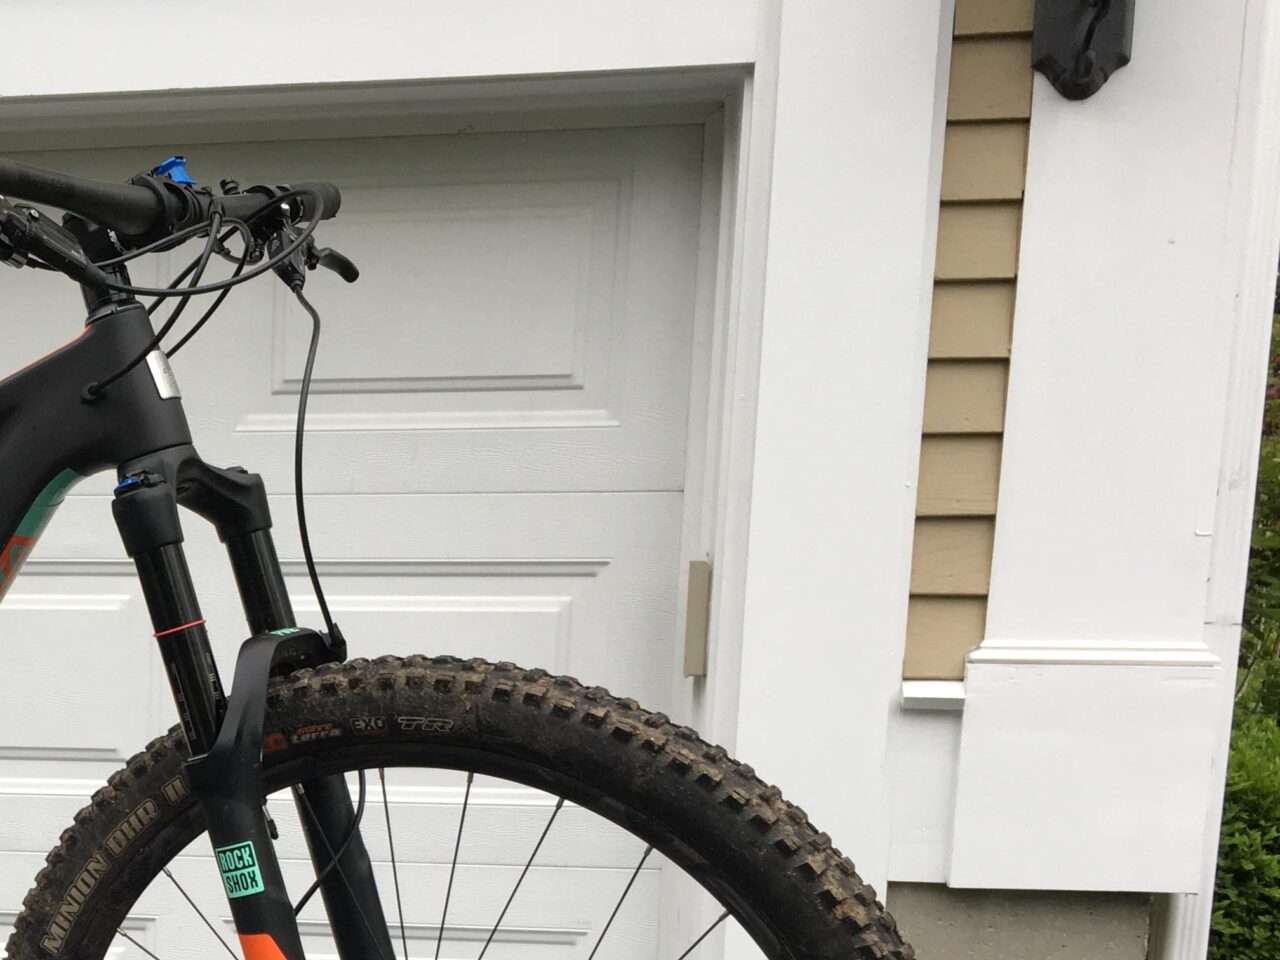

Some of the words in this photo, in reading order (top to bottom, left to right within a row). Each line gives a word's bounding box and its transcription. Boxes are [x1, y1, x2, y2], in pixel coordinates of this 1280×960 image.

[219, 846, 253, 871] ROCK
[40, 852, 110, 955] MINION
[104, 800, 159, 856] DHR
[225, 870, 259, 894] SHOX
